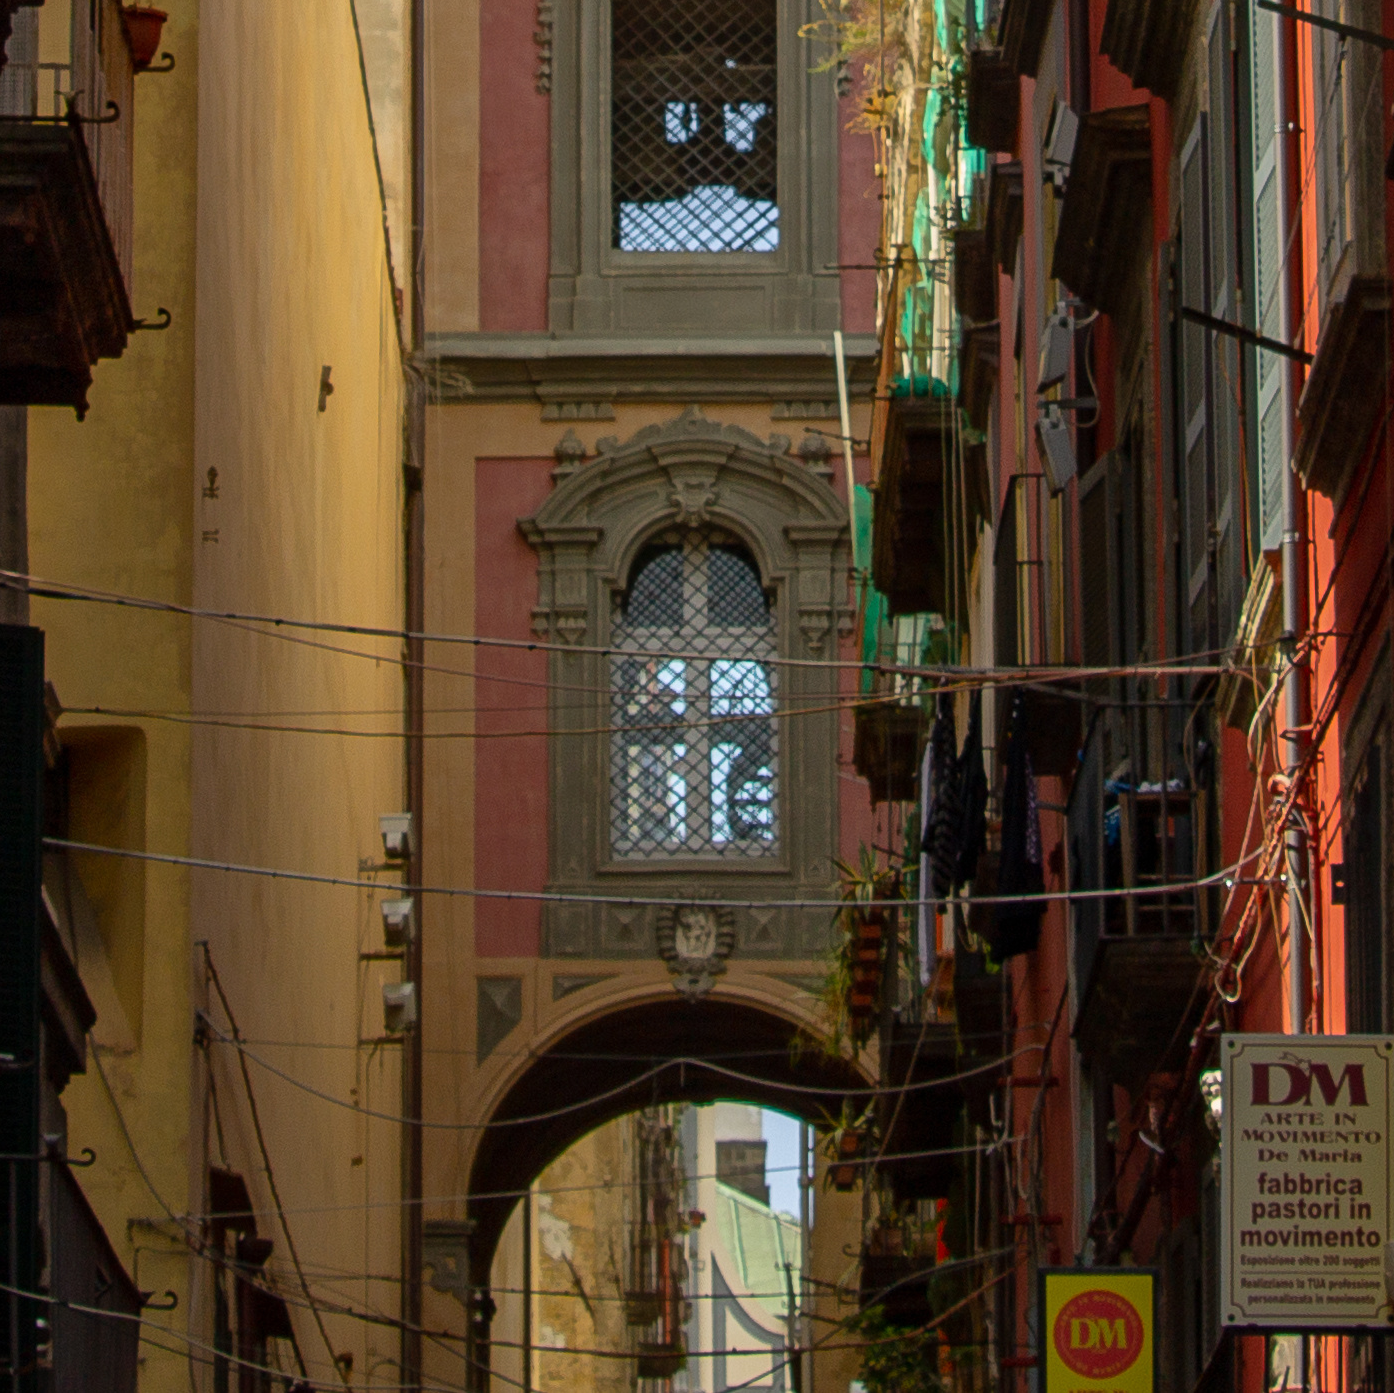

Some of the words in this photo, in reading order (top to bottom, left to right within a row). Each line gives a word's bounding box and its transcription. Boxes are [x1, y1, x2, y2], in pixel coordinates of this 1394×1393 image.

[1250, 1062, 1370, 1107] DM
[1260, 1112, 1324, 1125] ARTE
[1334, 1113, 1356, 1126] IN
[1241, 1128, 1382, 1144] MOVIMENTO
[1257, 1171, 1363, 1196] fabbrica
[1251, 1198, 1341, 1224] pastori
[1349, 1198, 1372, 1220] in
[1240, 1225, 1381, 1248] movimento
[1070, 1317, 1127, 1349] DM
